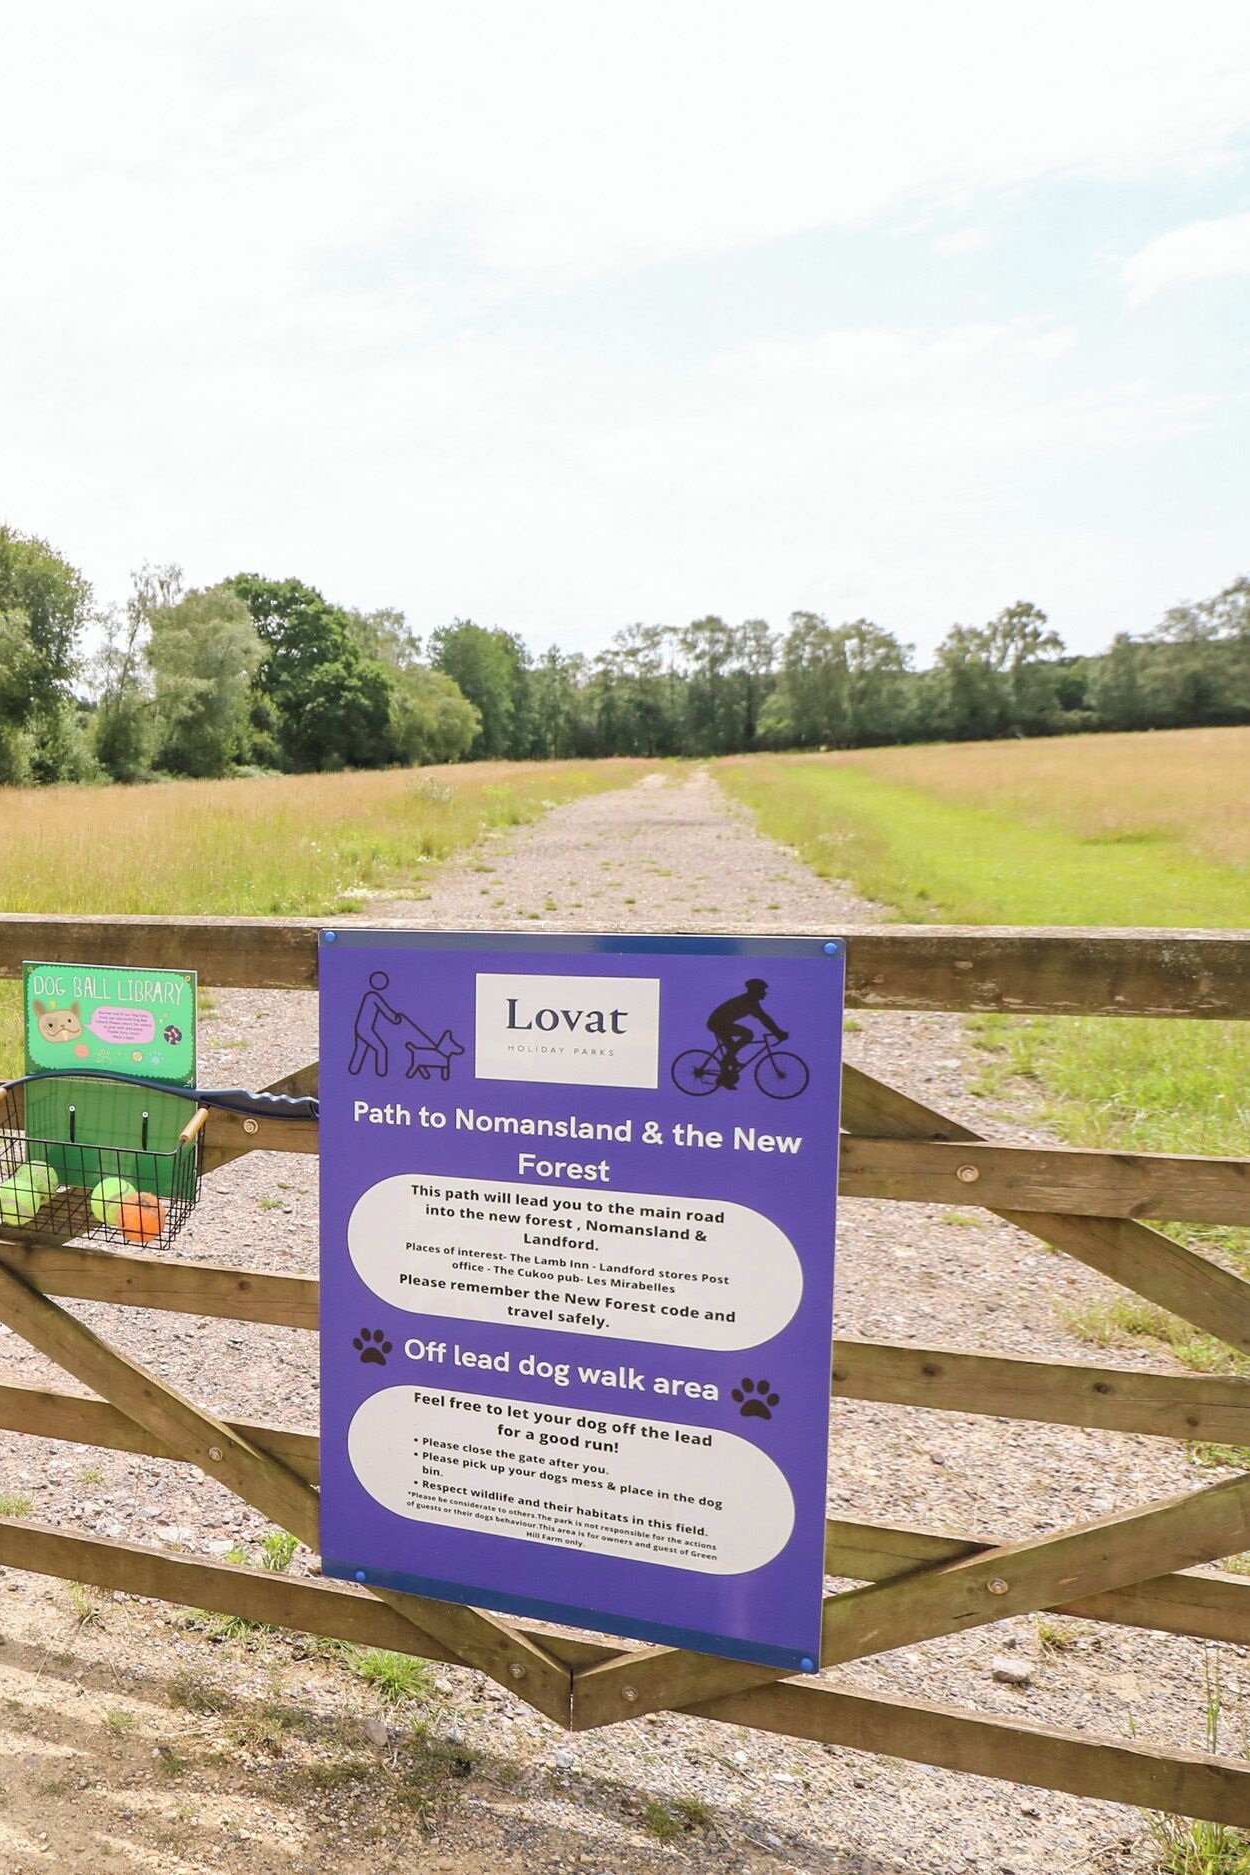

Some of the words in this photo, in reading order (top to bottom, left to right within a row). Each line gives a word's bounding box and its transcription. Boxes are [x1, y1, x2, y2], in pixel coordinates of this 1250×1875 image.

[33, 975, 66, 996] DOG
[72, 975, 111, 1000] BALL
[117, 978, 184, 1006] LIBRARY
[505, 997, 629, 1035] Lovat
[507, 1044, 565, 1054] HOLIDAY
[573, 1047, 614, 1057] PARKS
[353, 1100, 411, 1126] Path
[418, 1105, 447, 1129] to
[455, 1107, 632, 1143] Nomansland
[642, 1121, 663, 1145] &
[671, 1122, 723, 1149] the
[733, 1126, 803, 1154] New
[518, 1152, 610, 1183] Forest
[410, 1184, 441, 1198] This
[444, 1189, 479, 1202] path
[483, 1191, 511, 1205] will
[515, 1193, 548, 1208] lead
[552, 1199, 582, 1212] you
[586, 1200, 603, 1213] to
[607, 1202, 635, 1216] the
[639, 1206, 681, 1220] main
[686, 1211, 725, 1224] road
[425, 1203, 455, 1218] into
[459, 1207, 485, 1221] the
[488, 1212, 521, 1224] new
[524, 1213, 573, 1229] forest
[585, 1219, 690, 1241] Nomansland
[695, 1230, 706, 1241] &
[523, 1232, 599, 1251] Landford.
[405, 1241, 441, 1254] Places
[442, 1246, 455, 1255] of
[509, 1252, 531, 1264] The
[533, 1255, 567, 1268] Lamb
[569, 1259, 589, 1270] Inn
[599, 1262, 655, 1277] Landford
[658, 1270, 698, 1282] stores
[701, 1273, 729, 1285] Post
[451, 1260, 484, 1273] office
[493, 1264, 514, 1276] The
[516, 1267, 554, 1280] Cukoo
[586, 1275, 607, 1286] Les
[610, 1277, 675, 1294] Mirabelles
[399, 1273, 446, 1289] Please
[450, 1281, 530, 1299] remember
[533, 1289, 560, 1303] the
[564, 1292, 601, 1307] New
[604, 1297, 656, 1314] Forest
[660, 1305, 700, 1319] code
[703, 1310, 736, 1323] and
[506, 1305, 553, 1321] travel
[557, 1312, 610, 1330] safely.
[403, 1338, 447, 1364] Off
[453, 1343, 510, 1373] lead
[518, 1353, 570, 1387] dog
[576, 1365, 646, 1392] walk
[652, 1376, 719, 1402] area
[413, 1391, 445, 1407] Feel
[448, 1396, 482, 1413] free
[485, 1403, 503, 1416] to
[507, 1404, 529, 1420] let
[533, 1411, 572, 1426] your
[575, 1415, 607, 1435] dog
[611, 1421, 636, 1436] off
[640, 1425, 670, 1441] the
[674, 1429, 712, 1447] lead
[422, 1436, 460, 1451] Please
[461, 1443, 493, 1456] close
[495, 1448, 516, 1460] the
[517, 1453, 546, 1465] gate
[548, 1457, 580, 1470] after
[582, 1463, 609, 1475] you.
[496, 1423, 521, 1438] for
[525, 1431, 534, 1440] a
[538, 1432, 579, 1448] good
[584, 1439, 619, 1454] run!
[422, 1464, 443, 1477] bin.
[422, 1451, 459, 1466] Please
[462, 1458, 487, 1470] pick
[489, 1463, 505, 1475] up
[507, 1466, 536, 1478] your
[538, 1470, 568, 1485] dogs
[570, 1477, 603, 1489] mess
[607, 1482, 615, 1490] &
[619, 1484, 654, 1498] place
[656, 1488, 669, 1500] in
[672, 1492, 695, 1504] the
[698, 1496, 723, 1511] dog
[422, 1479, 467, 1496] Respect
[470, 1489, 515, 1504] wildlife
[517, 1497, 540, 1508] and
[543, 1500, 574, 1514] their
[576, 1505, 629, 1523] habitats
[631, 1514, 644, 1526] in
[647, 1518, 672, 1531] this
[675, 1522, 708, 1537] field.
[437, 1495, 449, 1505] be
[449, 1498, 497, 1512] considerate
[497, 1506, 507, 1514] to
[553, 1517, 573, 1526] park
[574, 1519, 583, 1528] is
[583, 1522, 599, 1530] not
[600, 1525, 651, 1539] responsible
[651, 1532, 665, 1542] for
[666, 1536, 683, 1545] the
[683, 1539, 717, 1551] actions
[415, 1502, 442, 1512] guests
[453, 1508, 473, 1517] their
[474, 1511, 494, 1522] dogs
[556, 1527, 576, 1536] area
[577, 1530, 585, 1538] is
[586, 1531, 600, 1540] for
[600, 1535, 633, 1546] owners
[634, 1541, 651, 1549] and
[652, 1544, 678, 1554] guest
[678, 1548, 689, 1556] of
[690, 1550, 718, 1561] Green
[525, 1530, 541, 1541] Hill
[541, 1533, 564, 1544] Farm
[564, 1537, 586, 1549] only.
